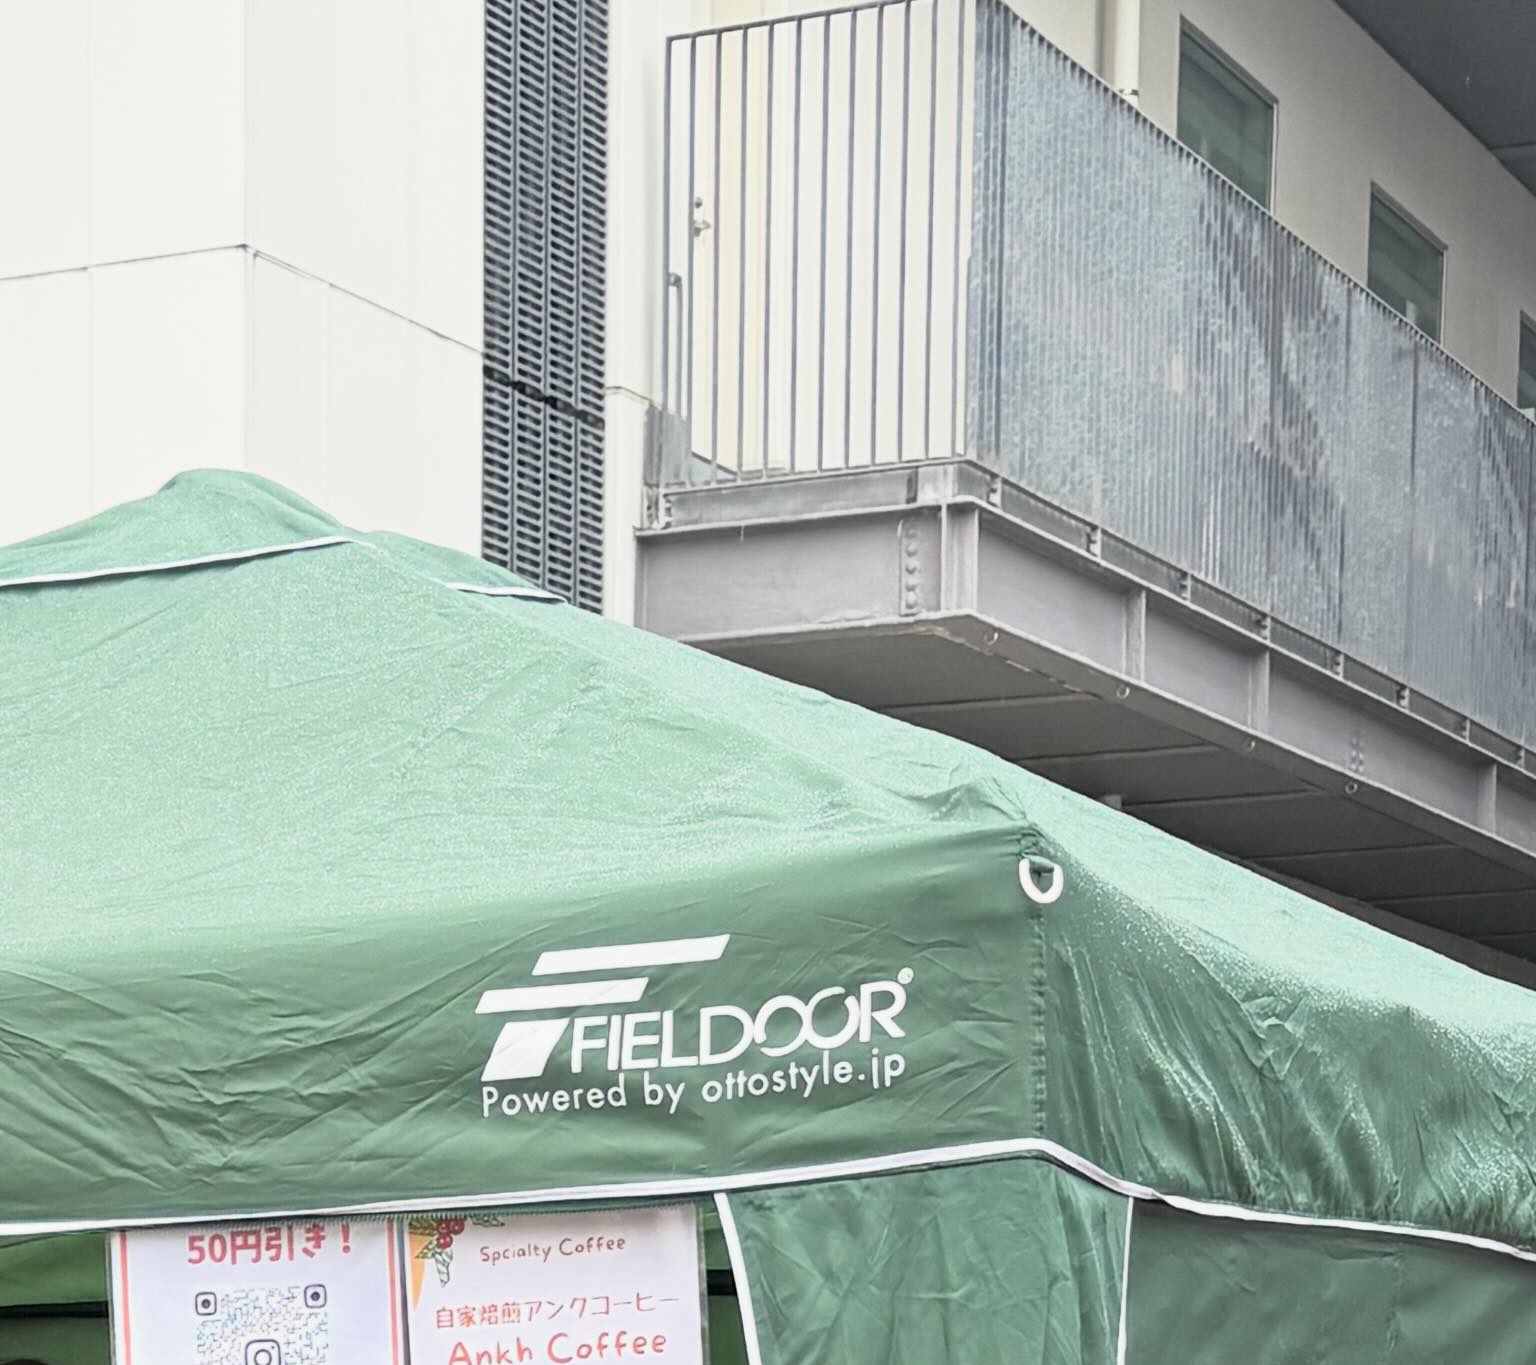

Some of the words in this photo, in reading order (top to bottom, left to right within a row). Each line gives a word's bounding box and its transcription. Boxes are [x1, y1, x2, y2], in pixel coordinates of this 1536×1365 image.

[569, 981, 907, 1075] FIELDOOR
[481, 1072, 628, 1119] Powered
[643, 1071, 684, 1115] by
[702, 1047, 906, 1103] ottostyle.jp
[559, 1235, 626, 1257] Coffee
[436, 1292, 680, 1329] 自家焙煎アンクコーヒー
[547, 1329, 667, 1364] Coffee
